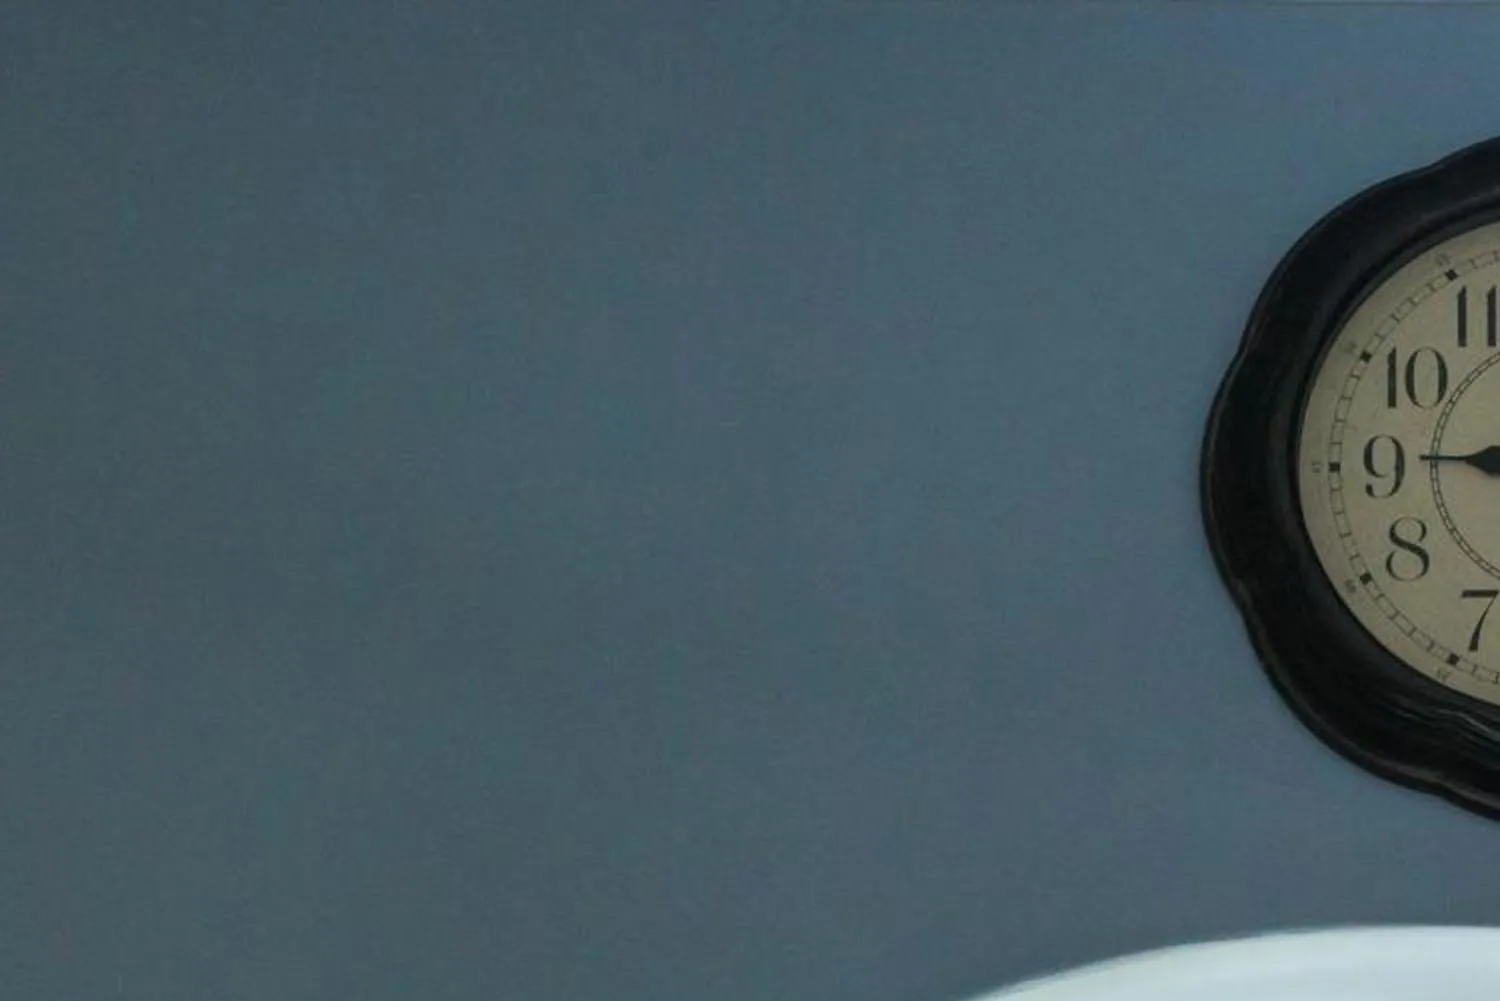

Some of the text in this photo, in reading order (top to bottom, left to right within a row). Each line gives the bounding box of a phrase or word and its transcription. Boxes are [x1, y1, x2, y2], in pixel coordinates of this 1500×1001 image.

[1456, 284, 1498, 348] 11
[1386, 346, 1449, 409] 10
[1362, 433, 1406, 500] 9
[1385, 515, 1431, 582] 8
[1461, 589, 1500, 653] 7
